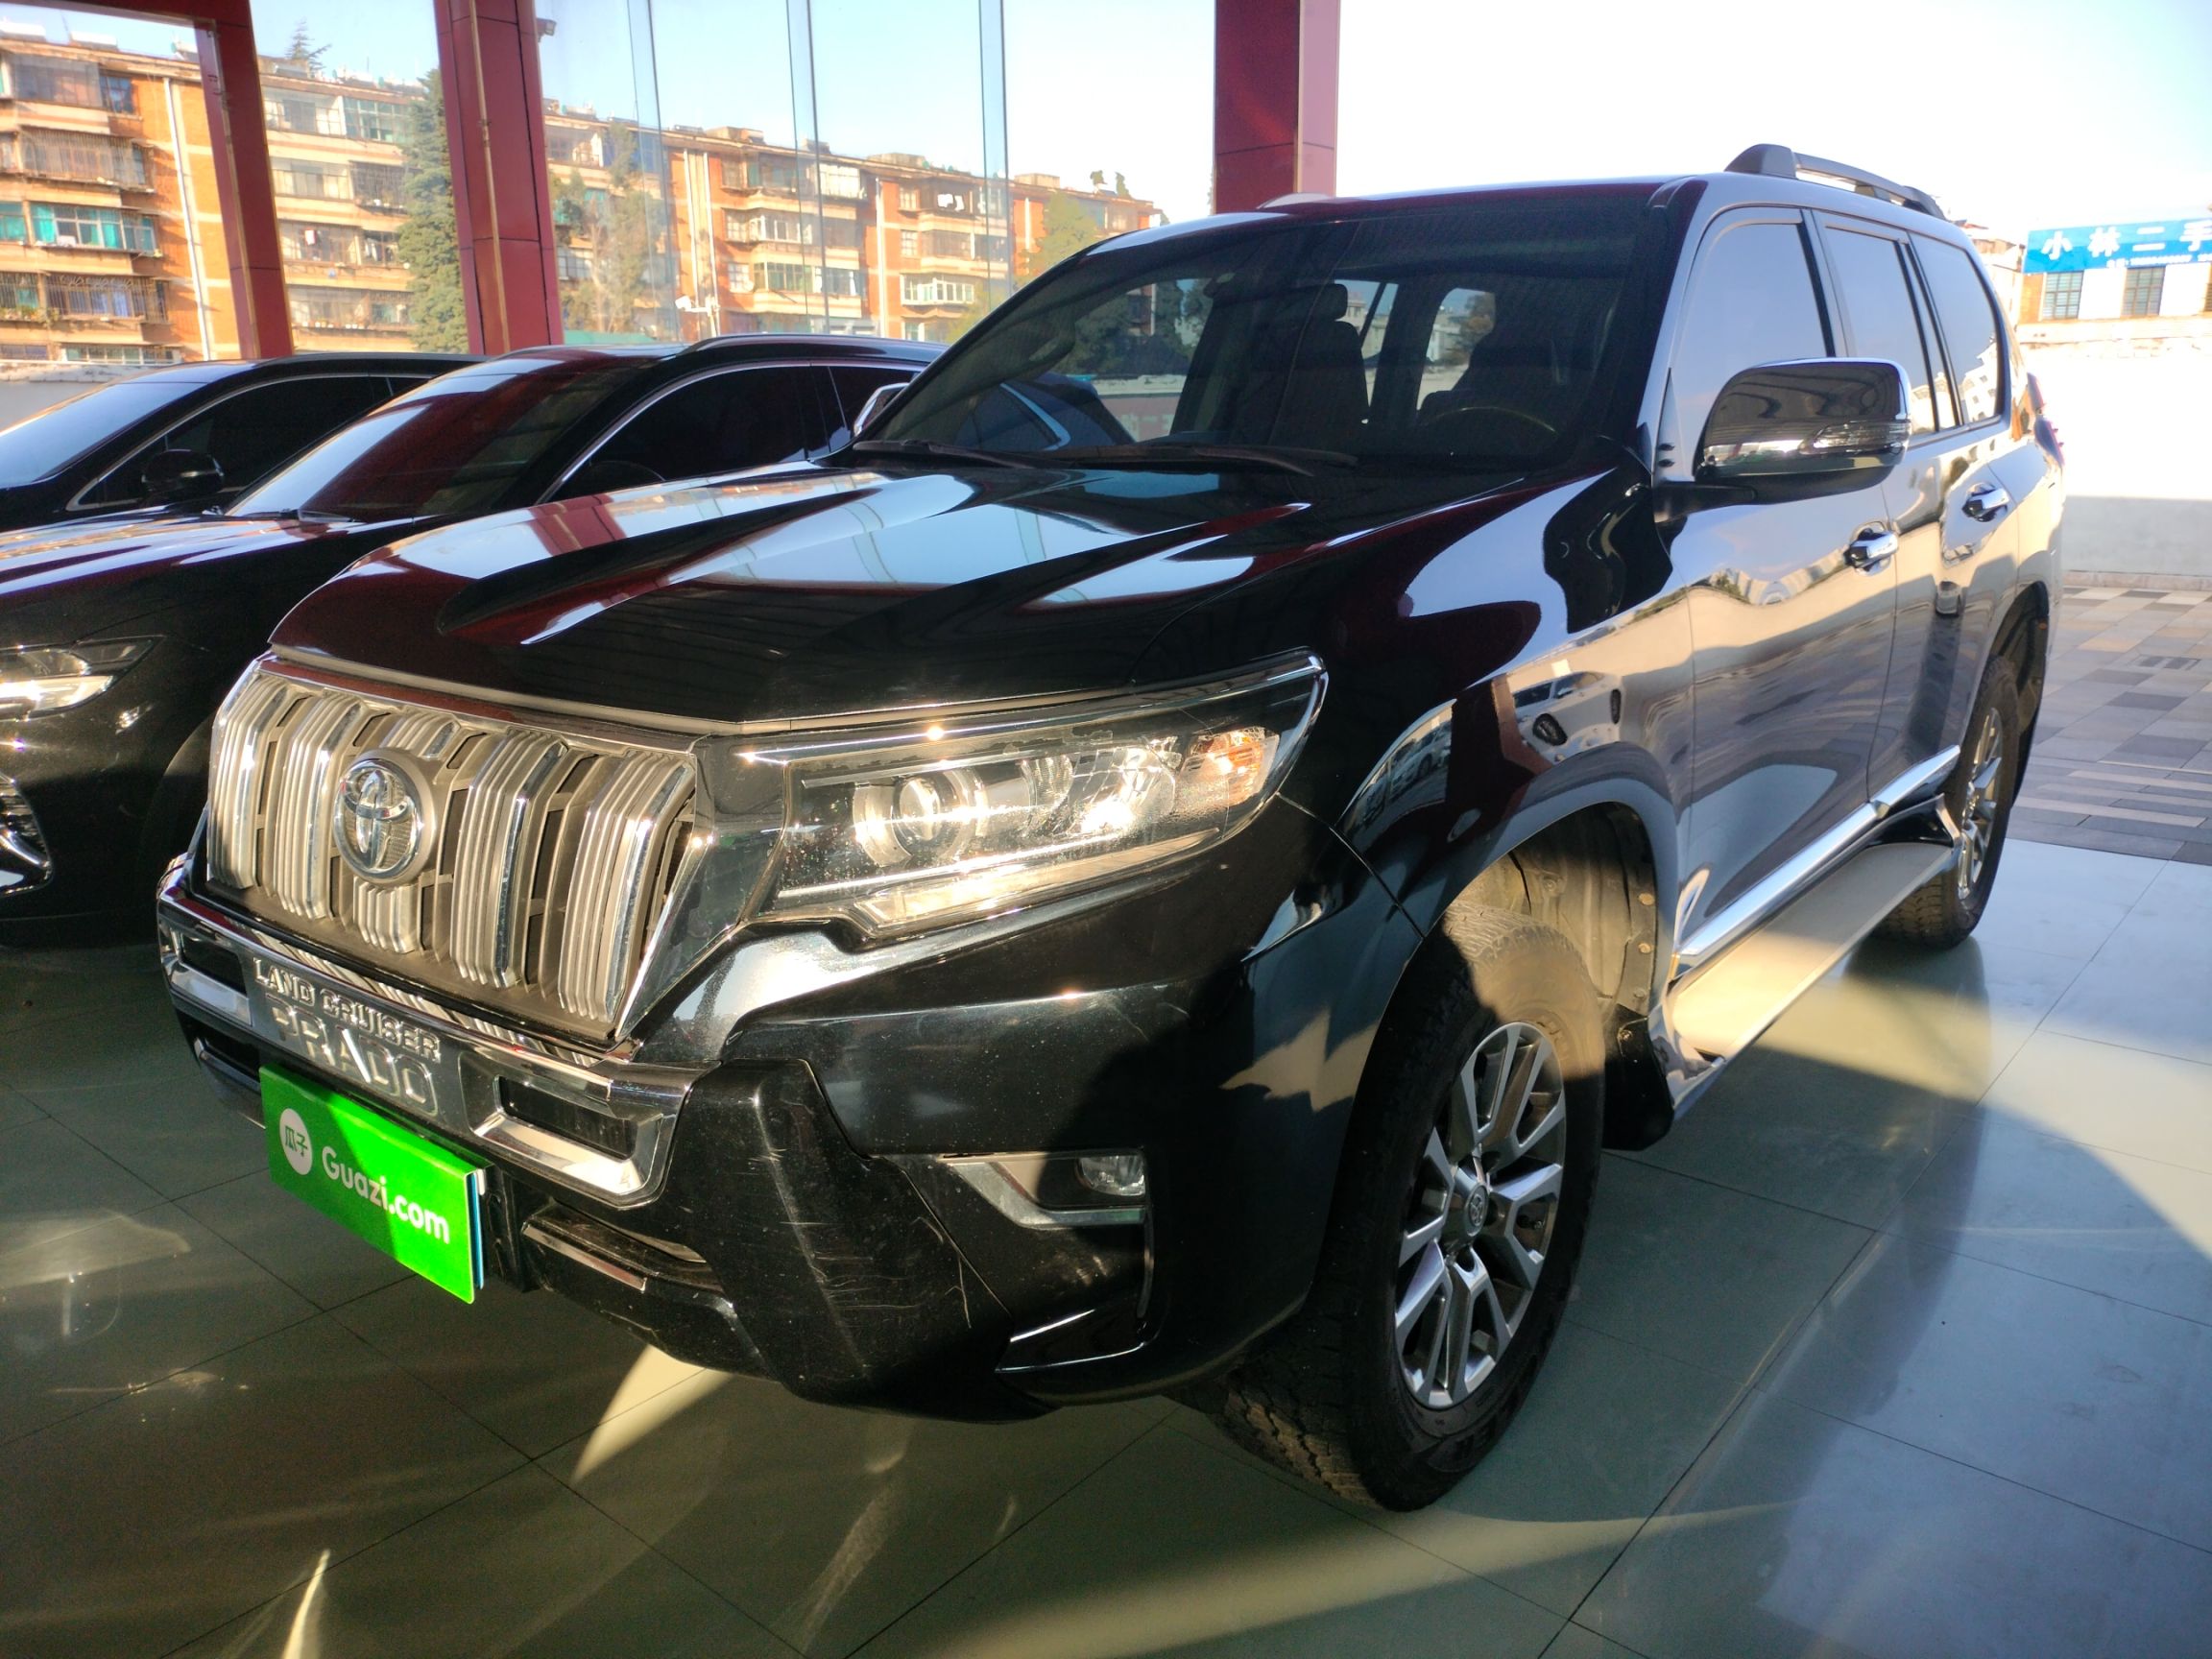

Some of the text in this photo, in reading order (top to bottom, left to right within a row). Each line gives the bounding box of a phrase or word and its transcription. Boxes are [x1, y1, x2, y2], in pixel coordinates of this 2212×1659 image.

[253, 957, 442, 1064] LAND CRUISER
[265, 993, 439, 1117] PRADO
[284, 1125, 309, 1158] 瓜子
[322, 1145, 450, 1244] Guazi.com
